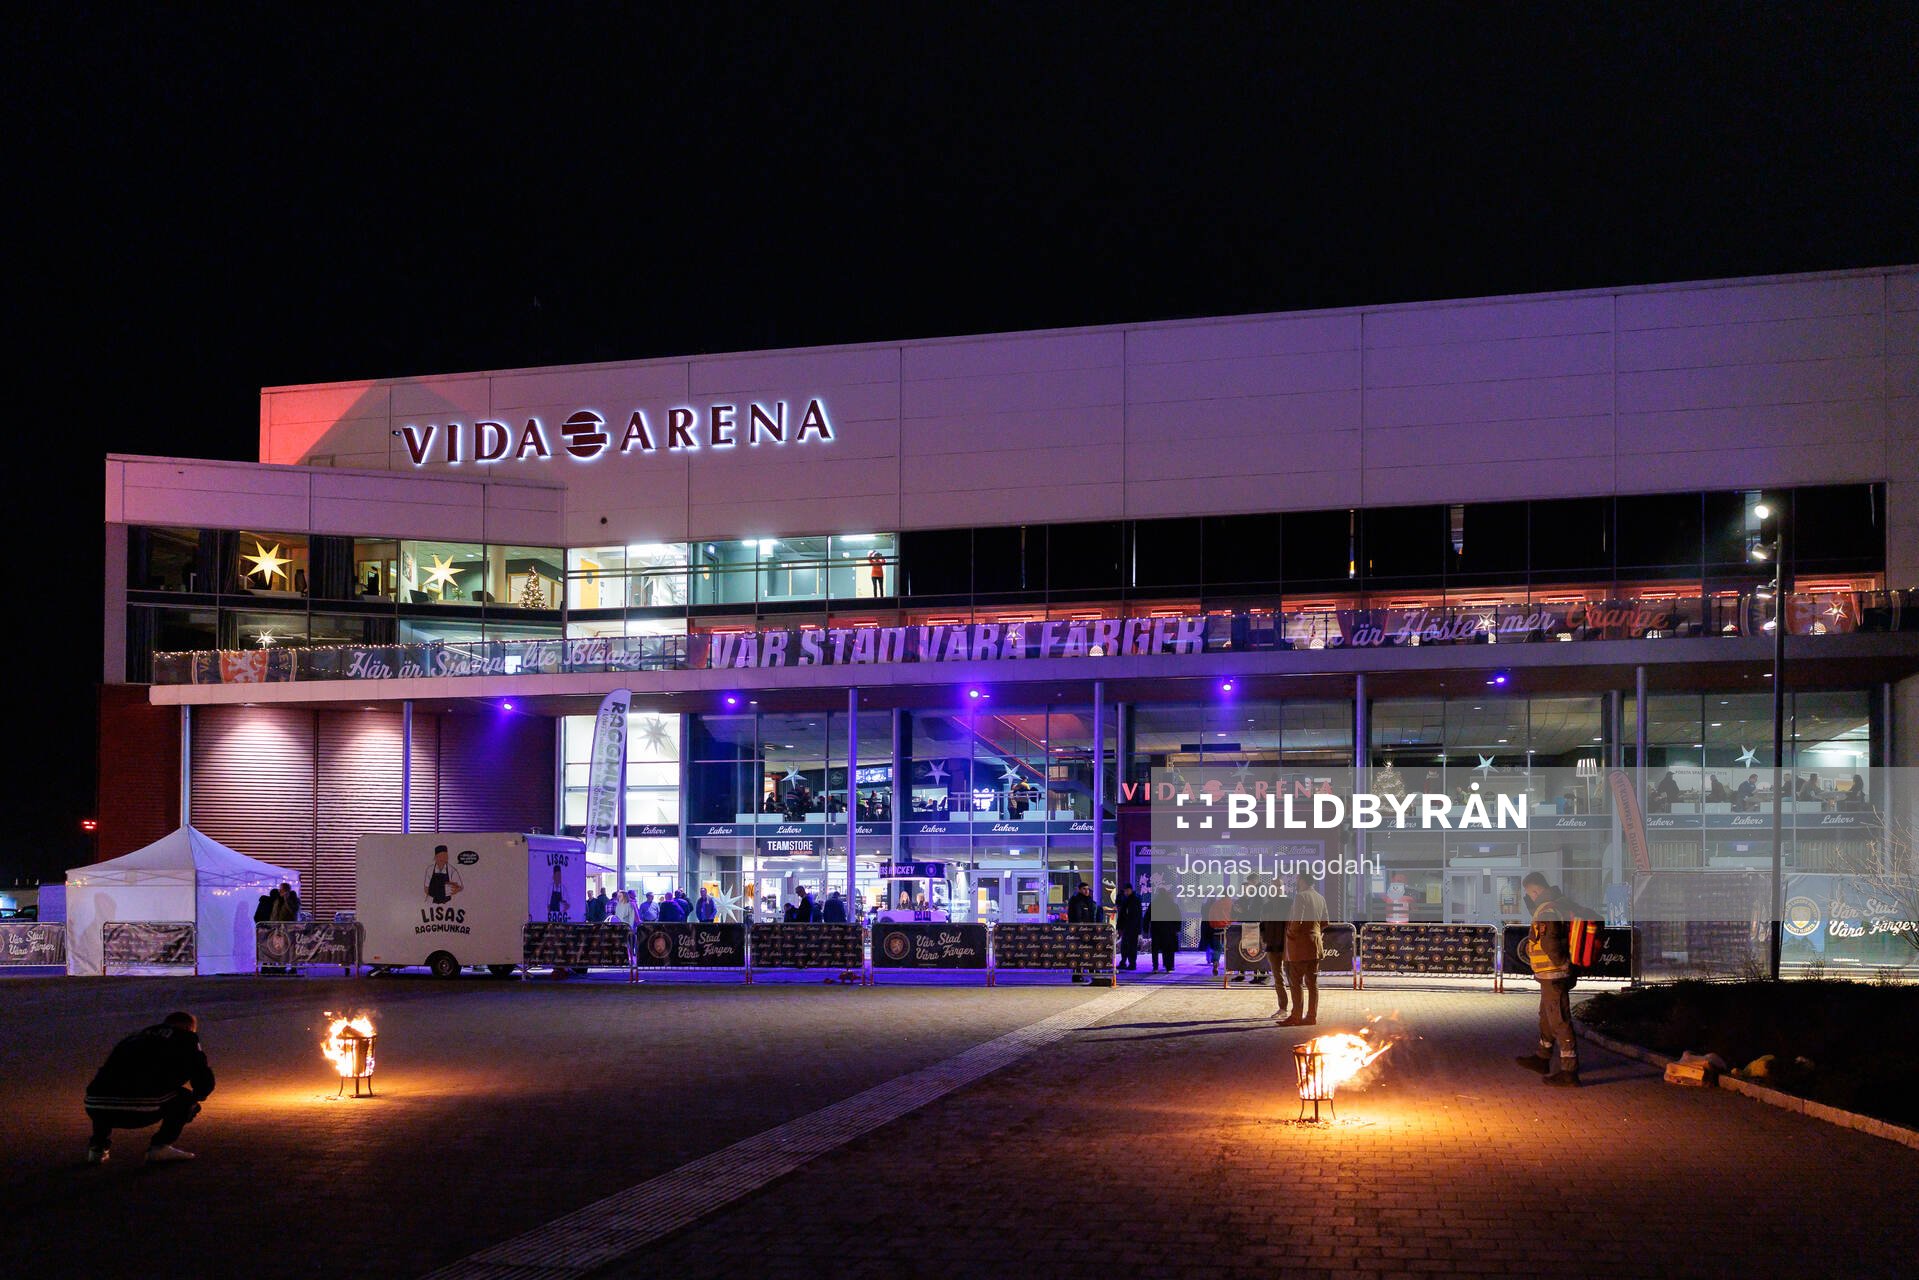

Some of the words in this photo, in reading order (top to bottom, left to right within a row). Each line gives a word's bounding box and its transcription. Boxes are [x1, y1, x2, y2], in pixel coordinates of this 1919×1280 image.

[402, 418, 551, 465] VIDA
[620, 399, 833, 452] ARENA
[1500, 611, 1555, 632] mer
[711, 631, 788, 669] VÅR
[798, 628, 906, 666] STAD
[919, 624, 1026, 661] VÅRA
[1040, 616, 1206, 657] FÄRGER
[347, 651, 393, 678] Här
[399, 660, 423, 678] är
[596, 701, 626, 845] RAGGMUNKAR
[1121, 782, 1195, 801] VIDA
[1234, 780, 1333, 799] ARENA
[1555, 818, 1587, 827] Lakers
[1731, 816, 1763, 825] Lakers
[1821, 815, 1854, 824] Lakers
[708, 826, 732, 835] Lakers
[776, 825, 802, 834] Lakers
[920, 824, 946, 833] Lakers
[992, 823, 1019, 833] Lakers
[767, 840, 813, 851] TEAMSTORE
[547, 854, 569, 867] LISAS
[421, 907, 466, 924] LISAS
[415, 924, 471, 935] RAGGMUNKAR
[1829, 920, 1866, 937] Våra
[938, 932, 961, 945] Stad
